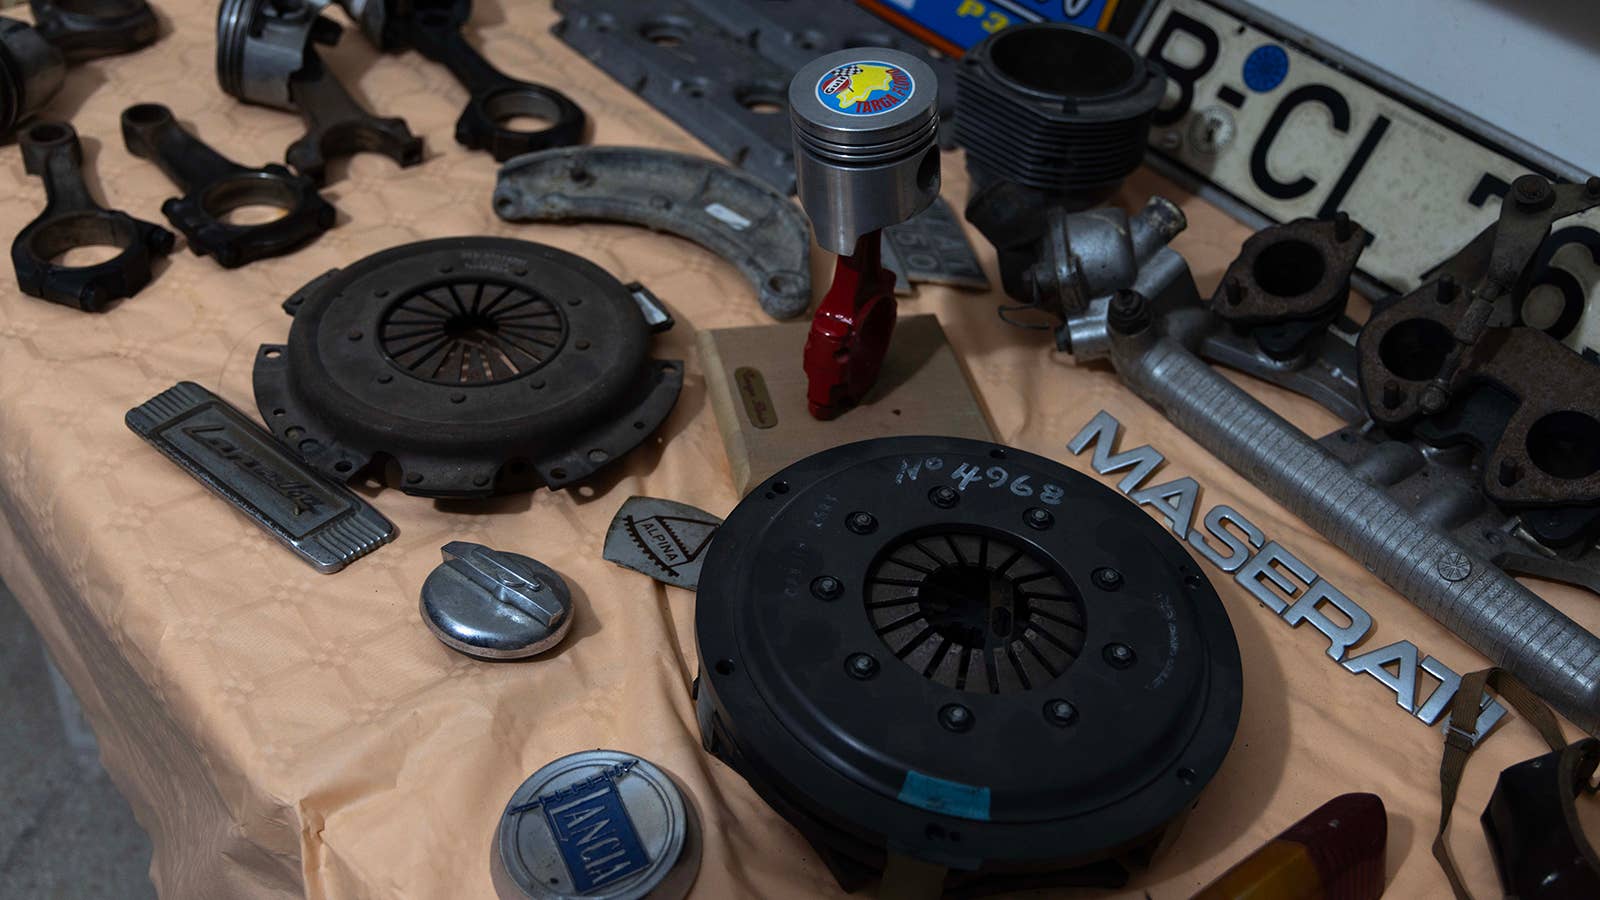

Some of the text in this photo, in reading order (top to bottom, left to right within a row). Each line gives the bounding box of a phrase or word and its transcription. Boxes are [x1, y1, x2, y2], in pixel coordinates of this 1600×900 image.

[825, 75, 849, 94] Gulf
[855, 93, 900, 113] TARGA
[951, 462, 1065, 505] 4968
[643, 522, 679, 562] ALPINA
[549, 786, 632, 886] LANCIA
